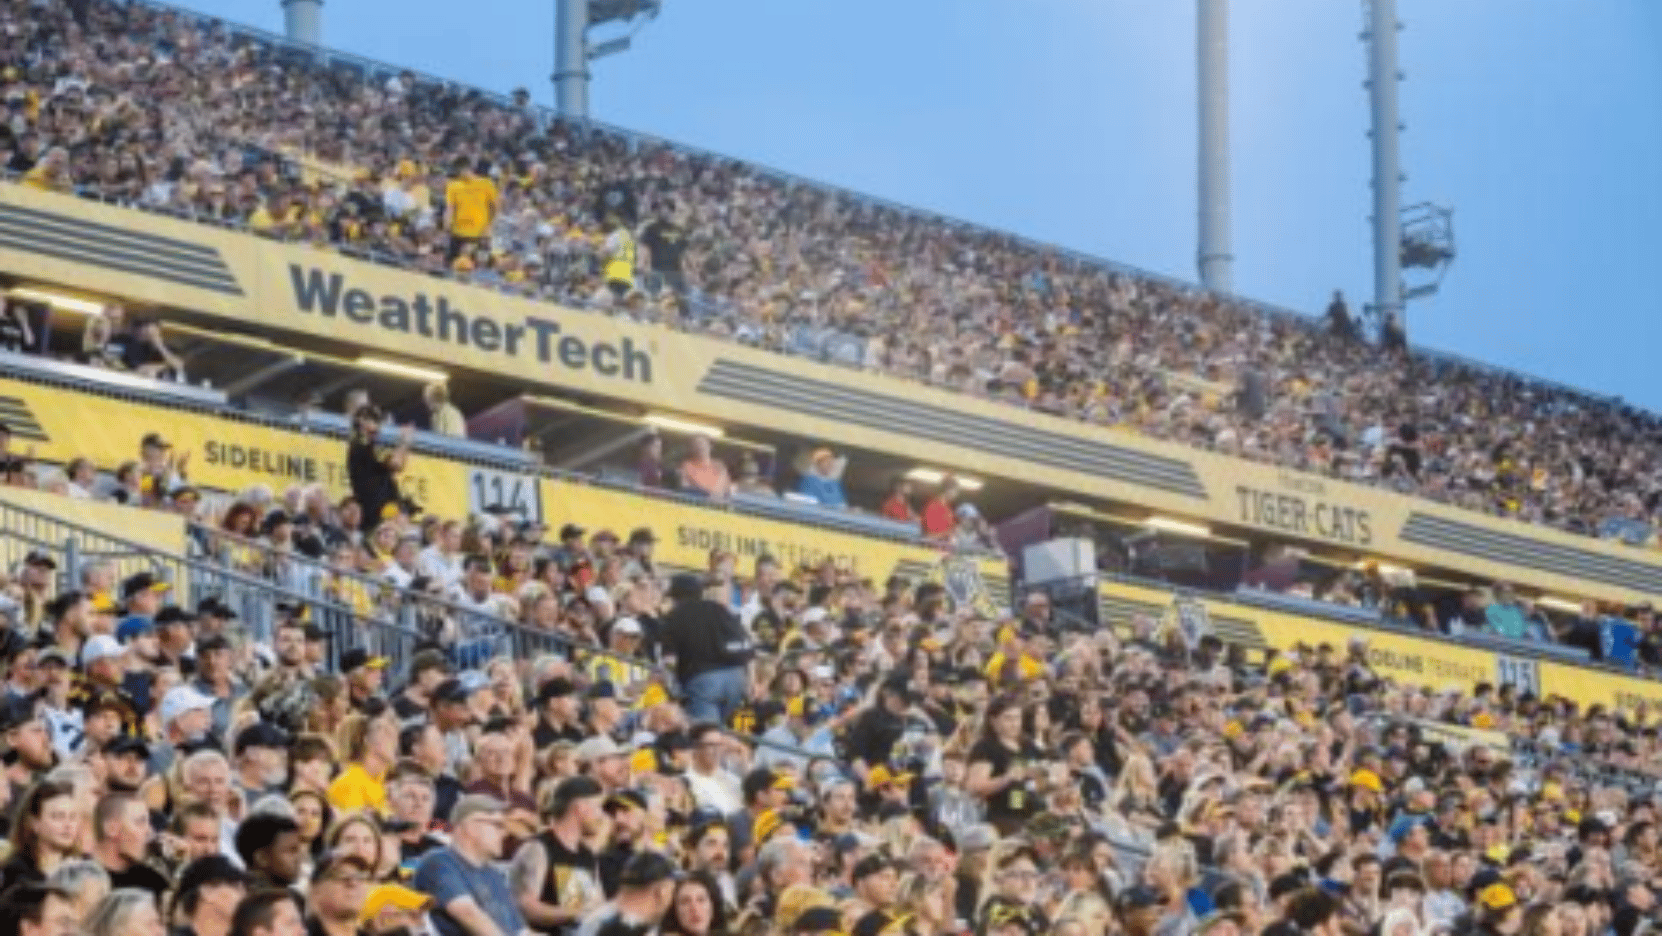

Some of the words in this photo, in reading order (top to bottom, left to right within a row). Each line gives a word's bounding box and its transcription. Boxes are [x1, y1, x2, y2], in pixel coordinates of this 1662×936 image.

[289, 264, 652, 382] WeatherTech
[204, 440, 316, 482] SIDELINE
[324, 461, 428, 502] TECE
[473, 472, 528, 519] 114
